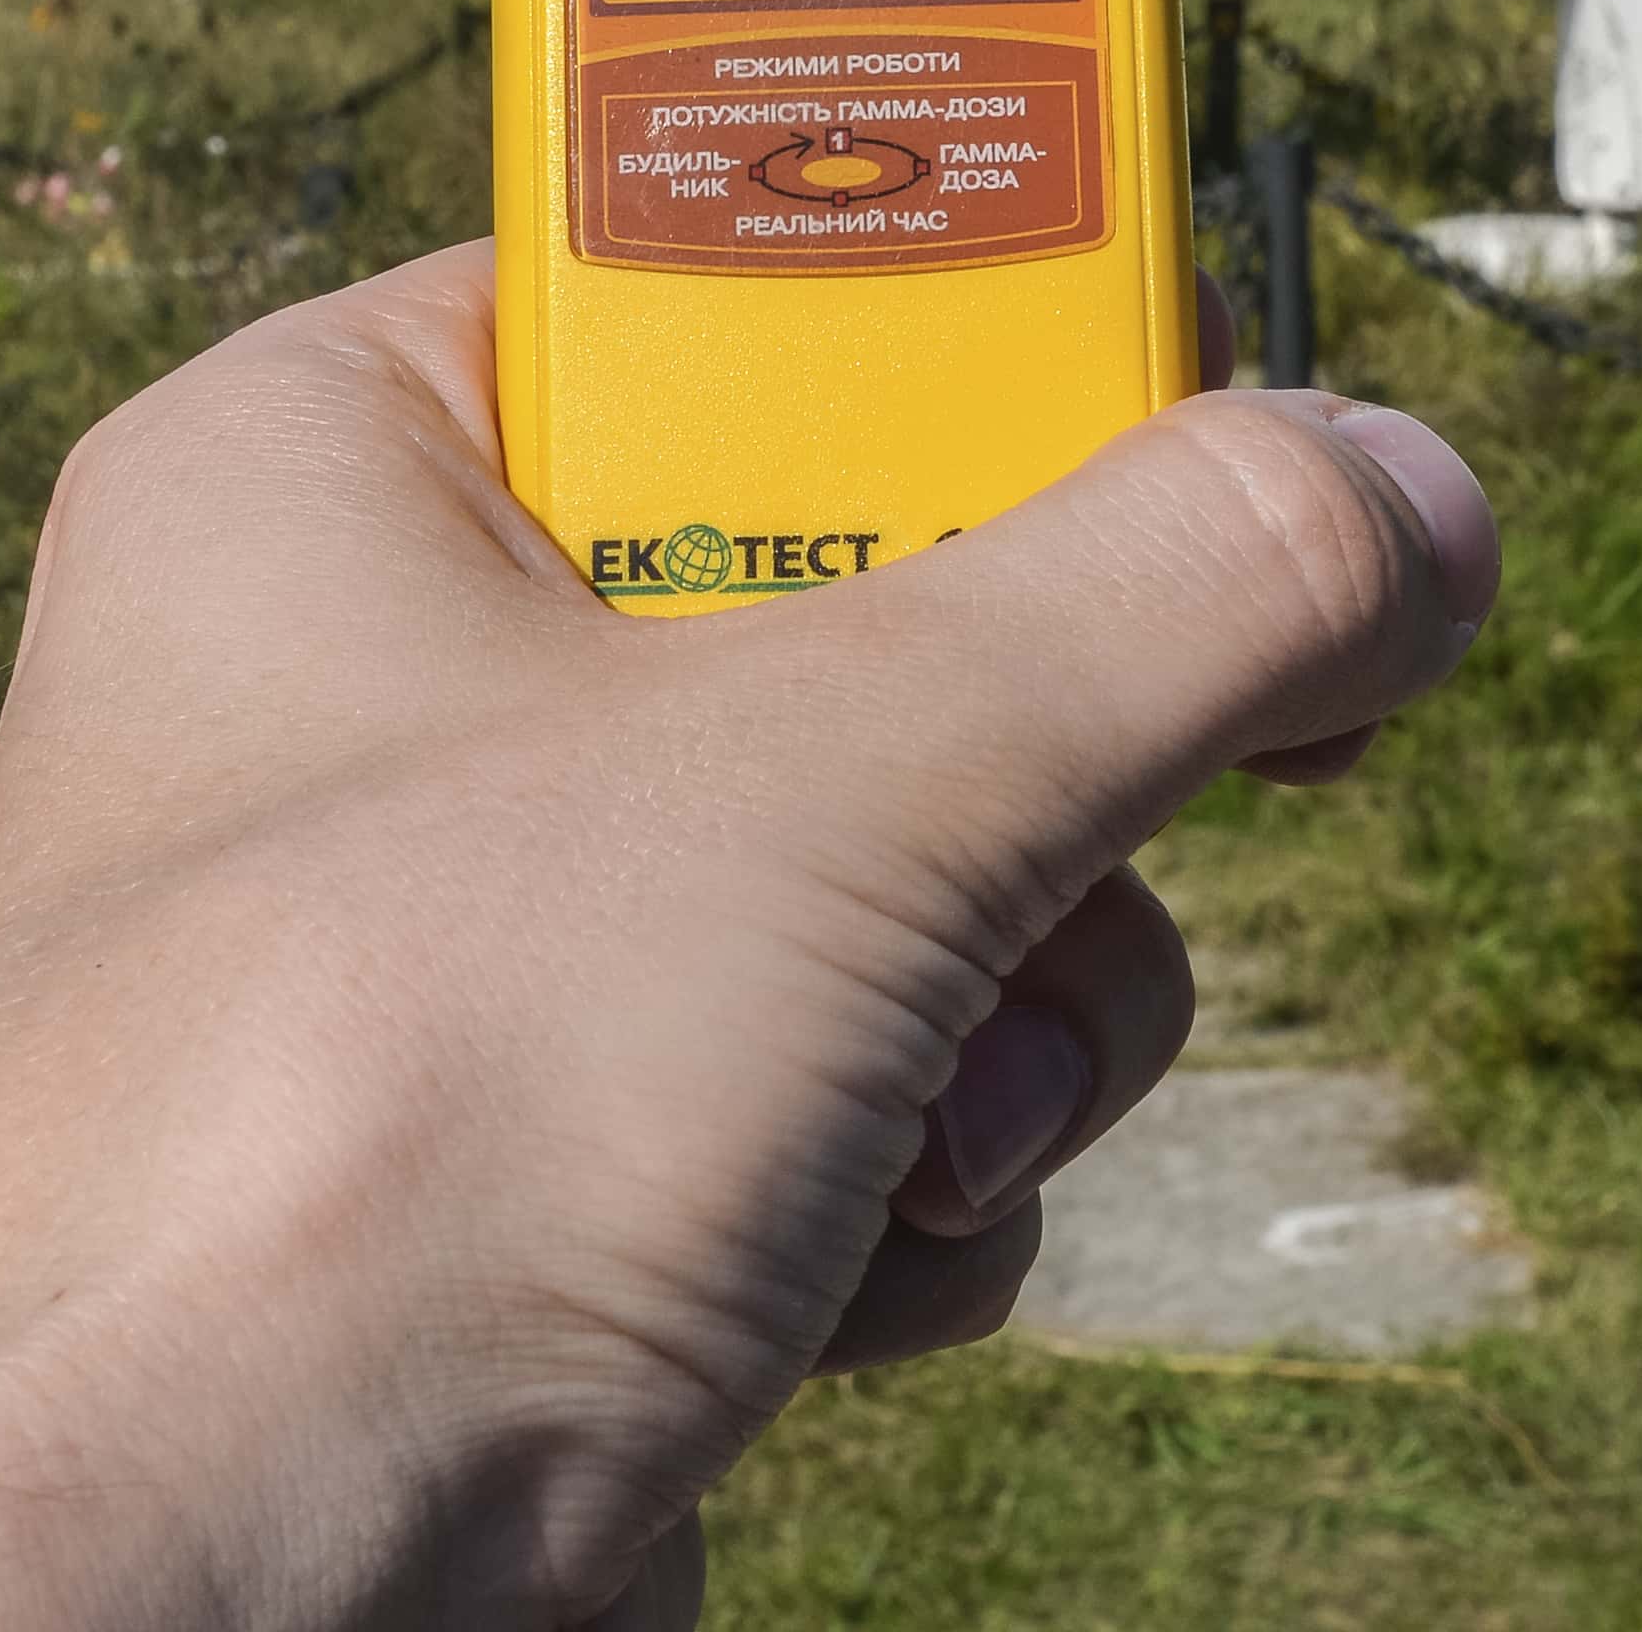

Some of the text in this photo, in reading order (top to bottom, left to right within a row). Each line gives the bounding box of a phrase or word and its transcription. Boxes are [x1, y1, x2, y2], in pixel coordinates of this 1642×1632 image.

[715, 52, 960, 79] РЕЖИМИ РОБОТИ
[652, 97, 1026, 129] ПОТУЖНІСТЬ ГАММА-ДОЗИ
[618, 151, 741, 176] БУДИЛЬ-
[940, 143, 1047, 166] ГАММА-
[670, 177, 730, 199] НИК
[939, 169, 1020, 194] ДОЗА
[735, 209, 949, 236] РЕАЛЬНИЙ ЧАС
